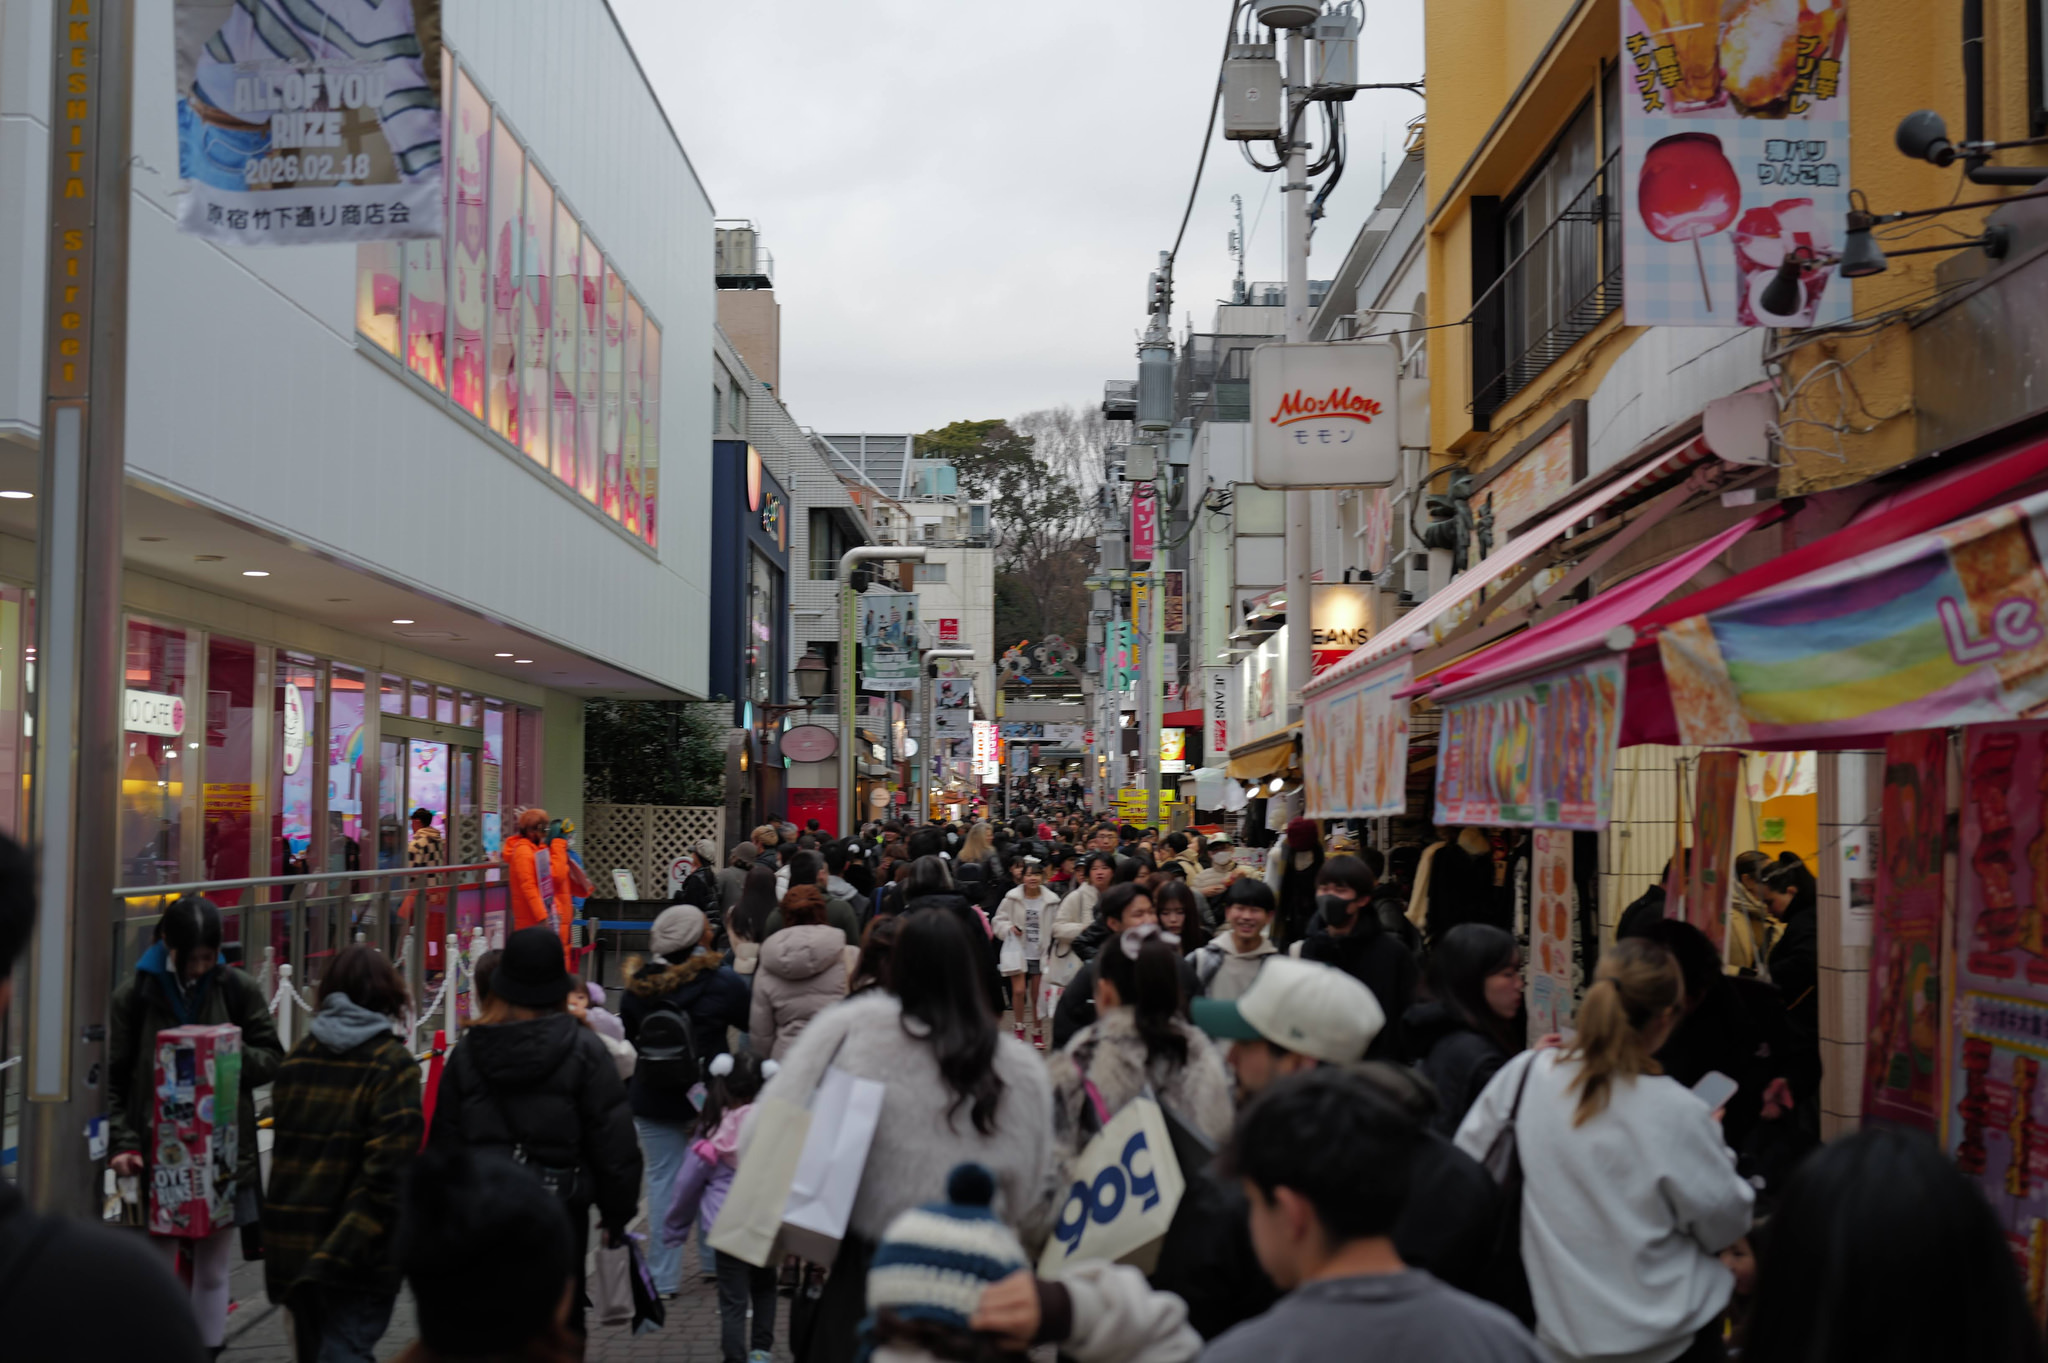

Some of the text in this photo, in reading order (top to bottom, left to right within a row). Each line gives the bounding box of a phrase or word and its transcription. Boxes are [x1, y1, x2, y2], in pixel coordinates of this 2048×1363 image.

[234, 72, 385, 113] ALL OF YOU
[271, 113, 345, 151] RIIZE
[244, 153, 370, 186] 2026.02.18
[206, 201, 411, 231] 原宿竹下通り商店会
[1293, 429, 1355, 444] モモン
[1213, 673, 1226, 719] JEANS
